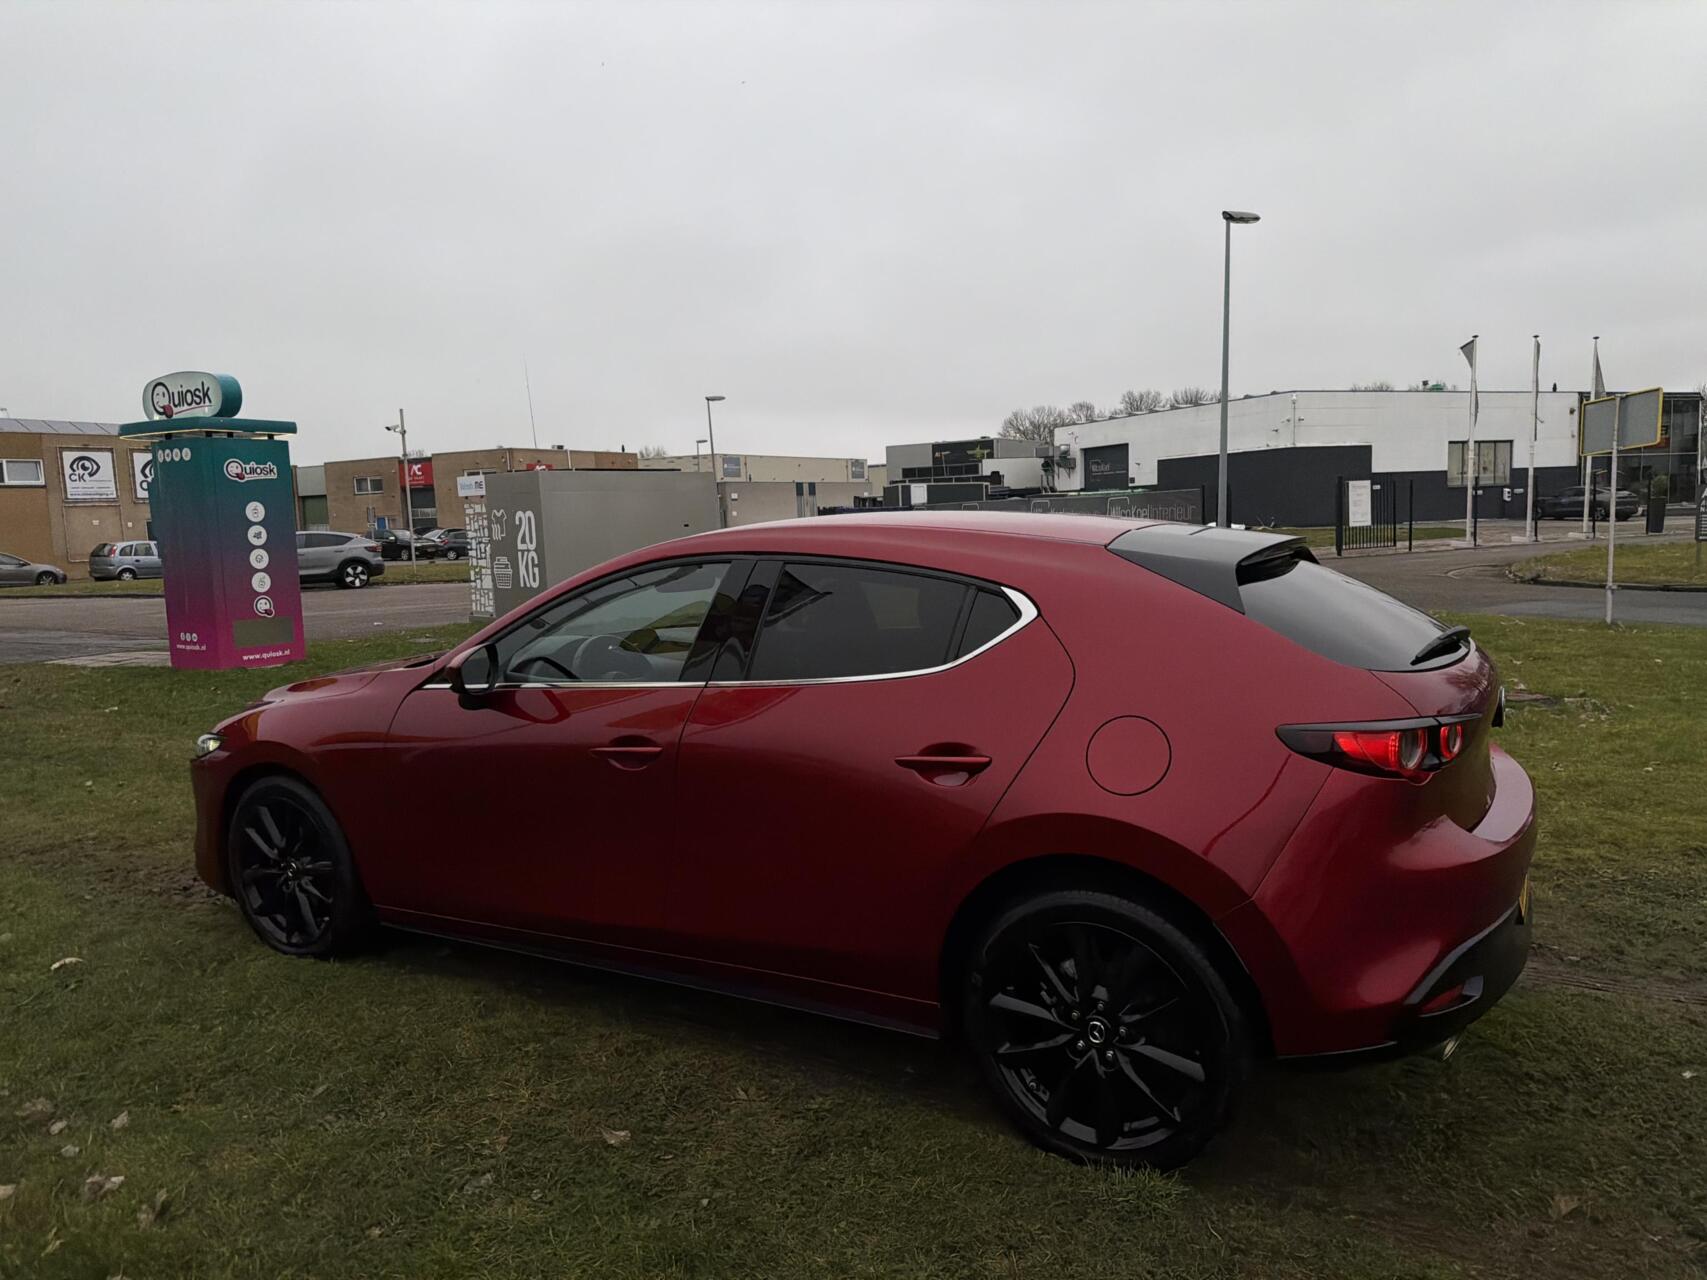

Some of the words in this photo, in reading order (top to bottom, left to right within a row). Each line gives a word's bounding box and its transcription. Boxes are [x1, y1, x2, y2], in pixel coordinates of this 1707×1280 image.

[151, 381, 212, 416] Quiosk
[69, 473, 86, 482] CK
[226, 461, 276, 479] Quiosk
[515, 510, 537, 550] 20
[518, 551, 540, 588] KG
[242, 649, 291, 661] www.quiosk.nl
